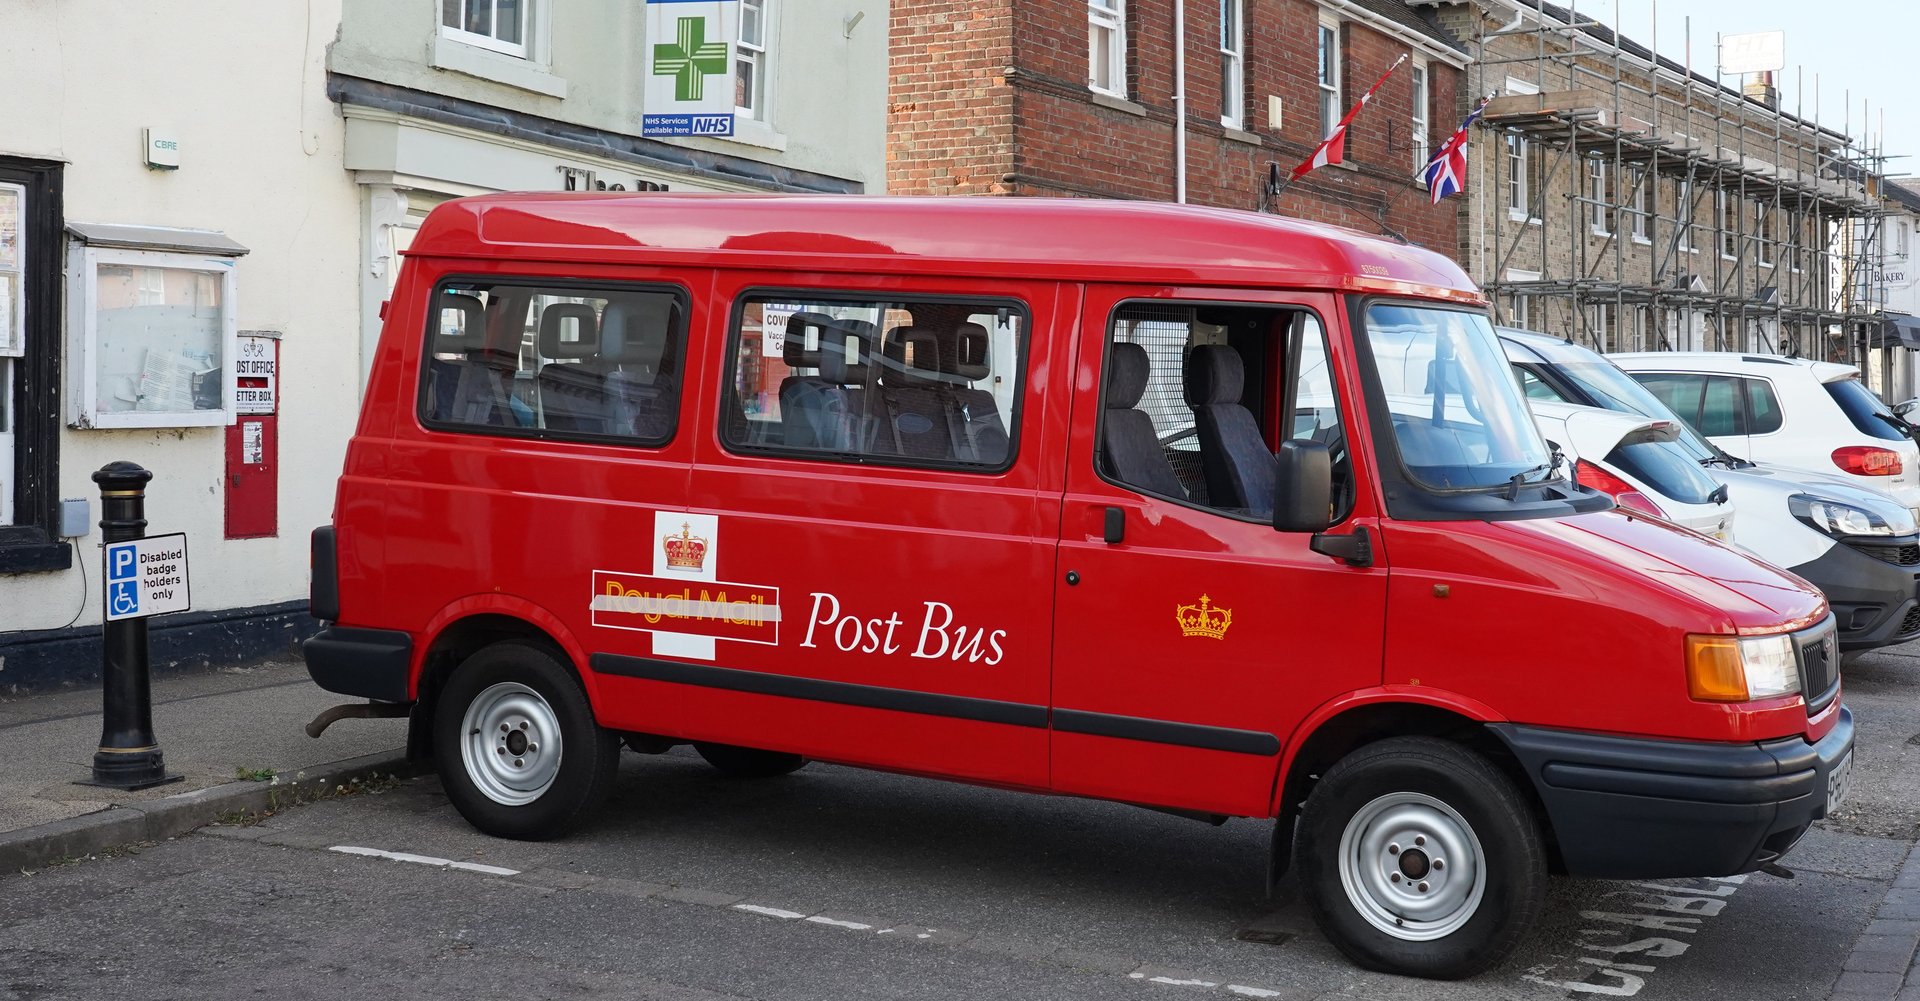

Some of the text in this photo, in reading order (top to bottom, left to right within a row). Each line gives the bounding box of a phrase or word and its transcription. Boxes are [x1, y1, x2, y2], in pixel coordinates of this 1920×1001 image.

[694, 118, 728, 132] NHS
[767, 315, 790, 326] COVI
[236, 360, 274, 374] OST OFFICE
[236, 390, 257, 402] ETTER
[140, 549, 182, 563] Disabled
[146, 563, 177, 576] badge
[143, 576, 181, 589] holders
[152, 588, 174, 600] only
[606, 580, 764, 627] Royal Mail
[800, 592, 1007, 666] Post Bus
